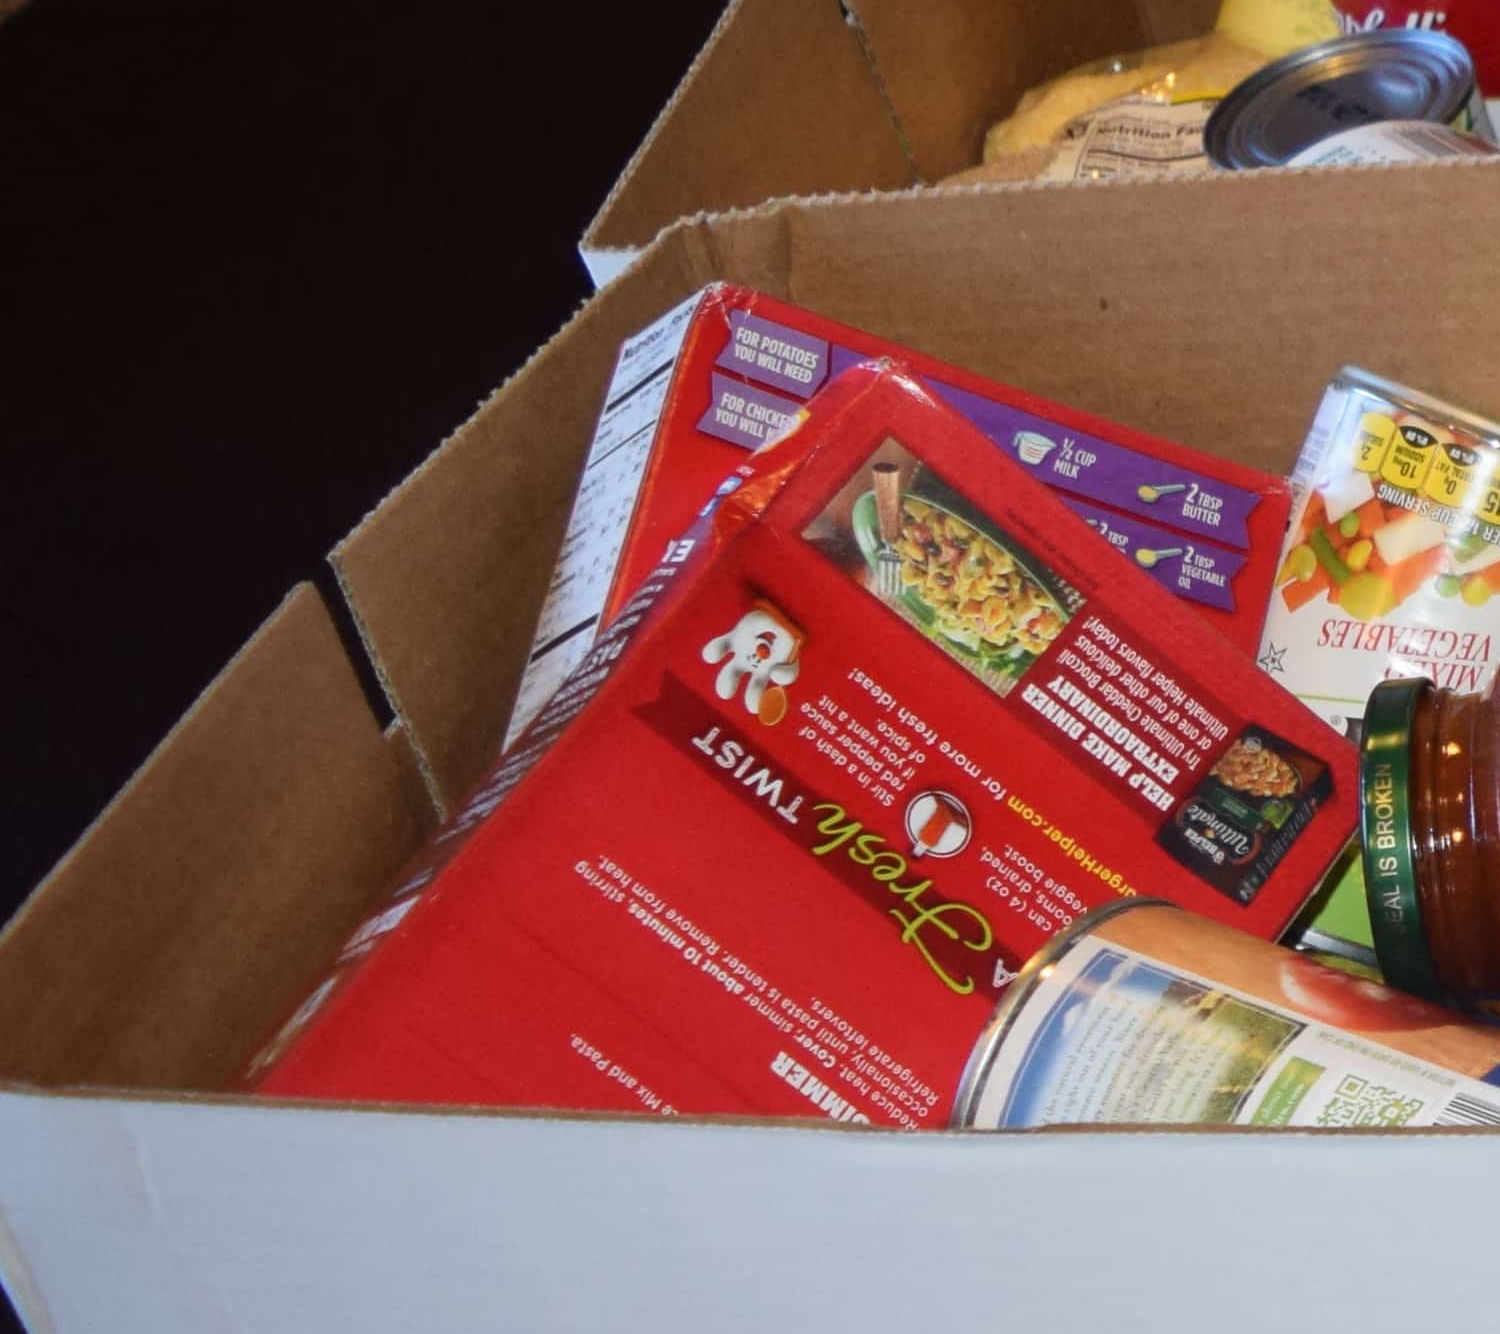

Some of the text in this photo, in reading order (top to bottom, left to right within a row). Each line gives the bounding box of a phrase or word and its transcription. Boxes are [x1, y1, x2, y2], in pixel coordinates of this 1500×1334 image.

[731, 344, 814, 384] YOU WILL NEED
[734, 327, 819, 369] FOR POTATOES
[713, 407, 739, 427] YOU
[737, 416, 766, 437] WILL
[719, 392, 746, 413] FOR
[1052, 459, 1081, 479] MILK
[1073, 449, 1097, 468] CUP
[1393, 444, 1427, 463] SODIUM
[1180, 502, 1222, 526] BUTTER
[1184, 482, 1224, 512] 2 TBSP
[1374, 482, 1432, 515] SERVING
[1176, 576, 1193, 590] OIL
[1179, 564, 1227, 587] VEGETABLE
[1183, 545, 1216, 570] 2 TBSP
[1315, 616, 1494, 664] VEGETABLES
[1070, 632, 1214, 751] or one of our other delicious
[1080, 612, 1231, 741] Ultimate Helper flavors today!
[844, 664, 1008, 801] for more fresh ideas!
[1018, 681, 1088, 741] DINNER
[1043, 671, 1183, 785] EXTRAORDINARY
[1054, 646, 1204, 770] Try Ultimate Cheddar Broccoli
[797, 700, 907, 793] red pepper sauce
[815, 693, 917, 779] if you want a hit
[871, 716, 928, 766] of spice.
[1079, 730, 1134, 778] MAKE
[796, 723, 897, 808] Stir in a dash of
[1126, 766, 1177, 812] HELP
[1182, 798, 1255, 857] Ultimate
[1366, 761, 1404, 878] IS BROKEN
[691, 721, 1020, 996] A Fresh TWIST
[975, 845, 1034, 896] drained,
[999, 842, 1090, 916] veggie boost.
[983, 873, 1054, 932] can (4 oz)
[571, 857, 920, 1133] Reduce heat. simmer about 10 minutes, stirring
[593, 852, 931, 1119] occasionally, until pasta is tender. Remove from heat.
[565, 1030, 662, 1111] Mix and Pasta.
[804, 995, 941, 1106] Refrigerate leftovers.
